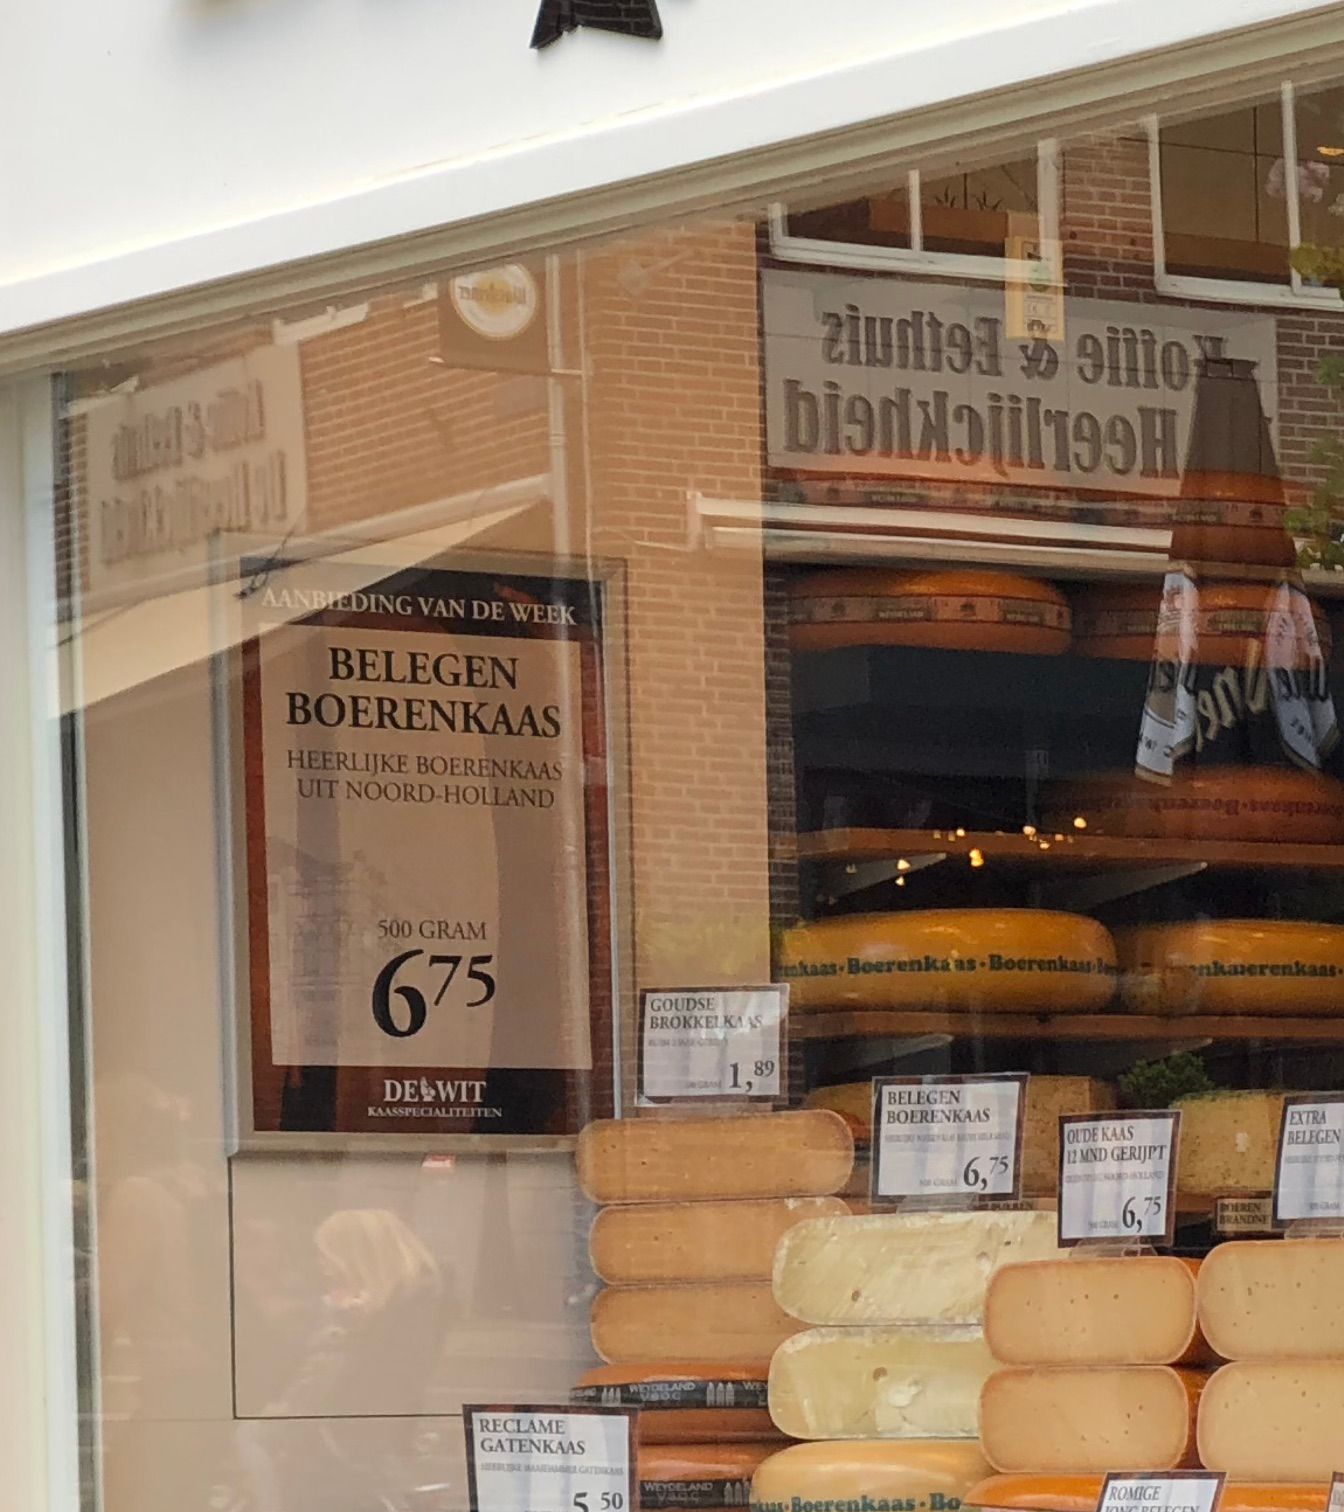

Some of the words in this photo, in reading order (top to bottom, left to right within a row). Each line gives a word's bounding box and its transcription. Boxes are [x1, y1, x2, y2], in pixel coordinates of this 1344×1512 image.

[261, 585, 413, 617] AANBIEDING
[417, 596, 466, 620] VAN
[472, 600, 505, 621] DE
[508, 602, 577, 627] WEEK
[328, 646, 520, 690] BELEGEN
[285, 691, 562, 738] BOERENKAAS
[287, 749, 409, 778] HEERLIJKE
[416, 755, 563, 782] BOERENKAAS
[296, 777, 340, 800] UIT
[345, 780, 555, 810] NOORD-HOLLAND
[377, 919, 412, 939] 500
[419, 920, 487, 941] GRAM
[650, 997, 715, 1012] GOUDSE
[649, 1014, 763, 1030] BROKKELKAAS
[729, 1060, 775, 1092] 1,89
[383, 1079, 419, 1103] DE
[435, 1080, 487, 1103] WIT
[887, 1090, 961, 1105] BELEGEN
[367, 1106, 502, 1118] KAASSPECIALITEITEN
[886, 1108, 991, 1125] BOERENKAAS
[1289, 1110, 1327, 1125] EXTRA
[1067, 1127, 1098, 1144] OUDE
[1101, 1125, 1135, 1142] KAAS
[1287, 1129, 1340, 1146] BELEGEN
[1066, 1150, 1078, 1165] 12
[1079, 1147, 1108, 1164] MND
[1110, 1145, 1167, 1164] GERIJPT
[962, 1155, 1009, 1191] 6,75
[1121, 1195, 1162, 1232] 6,75
[628, 1382, 696, 1393] WEYDELAND
[479, 1418, 566, 1435] RECLAME
[480, 1438, 586, 1456] GATENKAAS
[643, 1482, 714, 1492] WEYDELAND
[1108, 1485, 1162, 1501] ROMIGE
